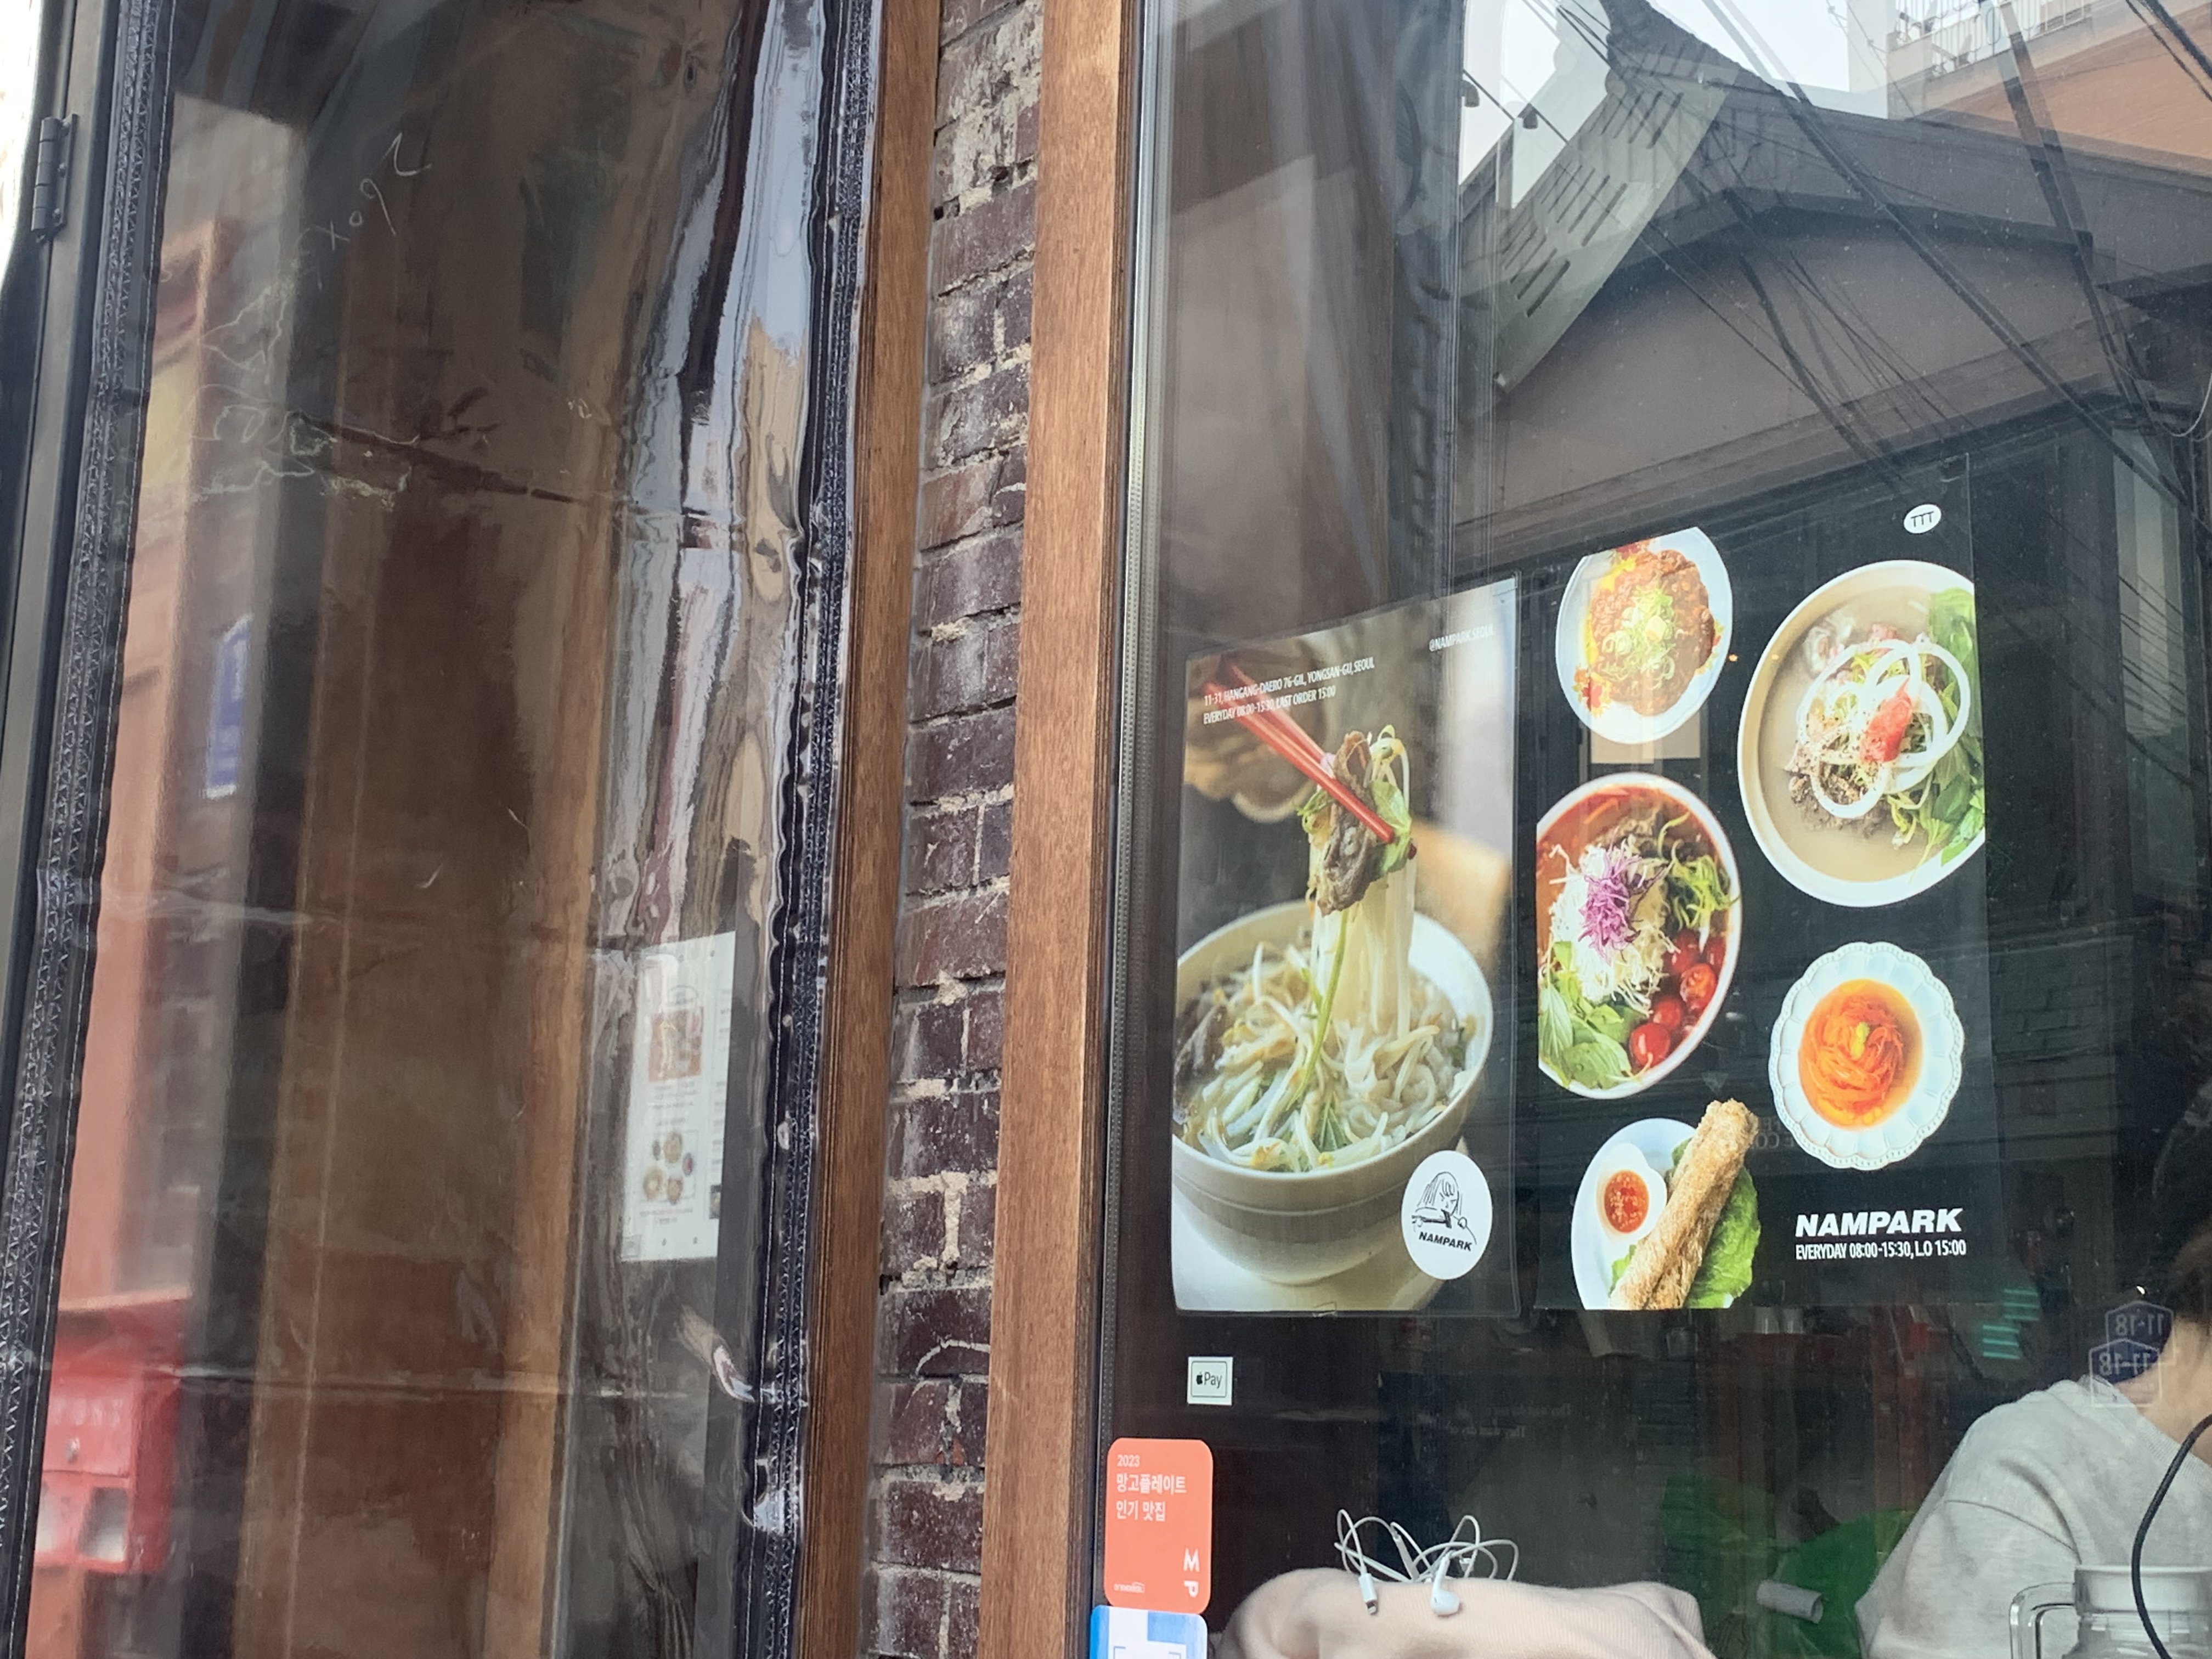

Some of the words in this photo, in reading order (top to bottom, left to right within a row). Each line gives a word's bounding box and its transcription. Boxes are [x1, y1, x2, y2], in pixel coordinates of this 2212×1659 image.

[1910, 510, 1934, 528] TTT
[1224, 678, 1283, 702] HANGANG-DAERO
[1283, 673, 1306, 689] 76-GIL,
[1203, 708, 1237, 725] EVERYDAY
[1276, 695, 1293, 709] LAST
[1293, 689, 1317, 705] ORDER
[1318, 685, 1336, 699] 15:00
[1795, 1208, 1963, 1237] NAMPARK
[1418, 1231, 1472, 1252] NAMPARK
[1796, 1243, 1848, 1260] EVERYDAY
[1934, 1239, 1967, 1256] 15:00
[1204, 1371, 1222, 1389] Pay
[1117, 1454, 1141, 1468] 2023
[1116, 1473, 1187, 1494] 망고플레이트
[1116, 1500, 1139, 1521] 인기
[1142, 1500, 1166, 1522] 맛집
